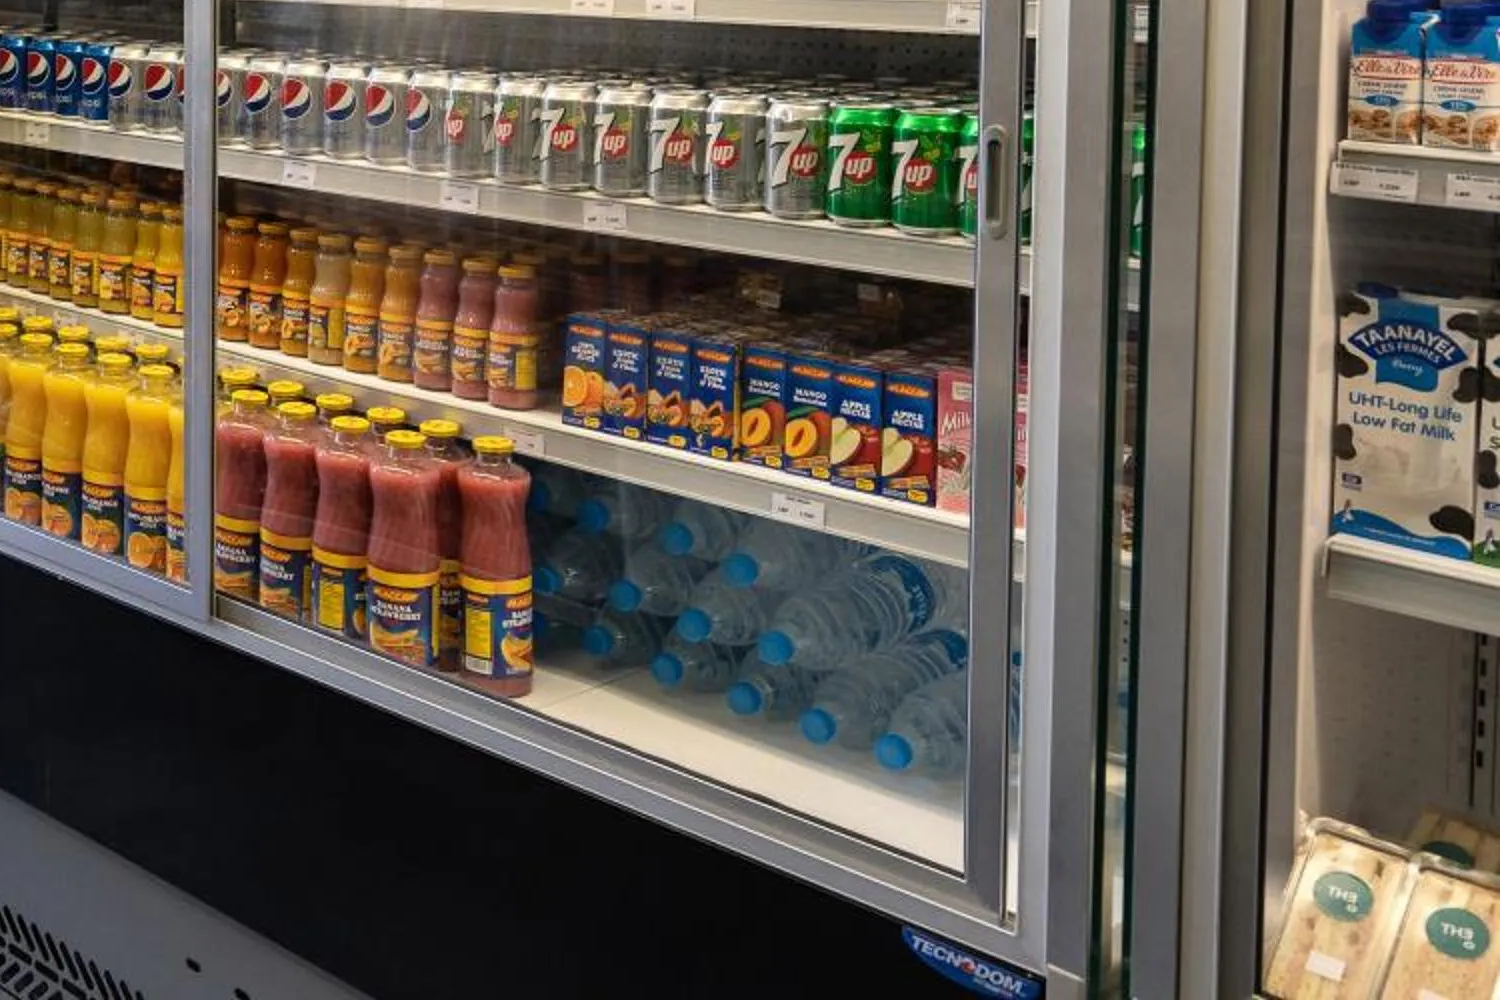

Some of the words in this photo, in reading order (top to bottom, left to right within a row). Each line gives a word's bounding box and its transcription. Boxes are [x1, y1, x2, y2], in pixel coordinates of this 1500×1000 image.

[648, 117, 692, 175] 7up
[770, 127, 819, 189] 7up
[828, 131, 875, 194] 7up
[891, 138, 934, 202] 7up
[1357, 323, 1457, 362] TAANAYEL
[1375, 340, 1395, 356] LES
[1396, 341, 1442, 364] FERMES
[795, 387, 828, 401] MANGO
[1349, 391, 1429, 420] UHT-Long
[1433, 407, 1463, 423] Life
[1353, 411, 1386, 430] Low
[1390, 417, 1417, 435] Fat
[1420, 423, 1457, 442] Milk
[911, 934, 1025, 995] TECNODOM
